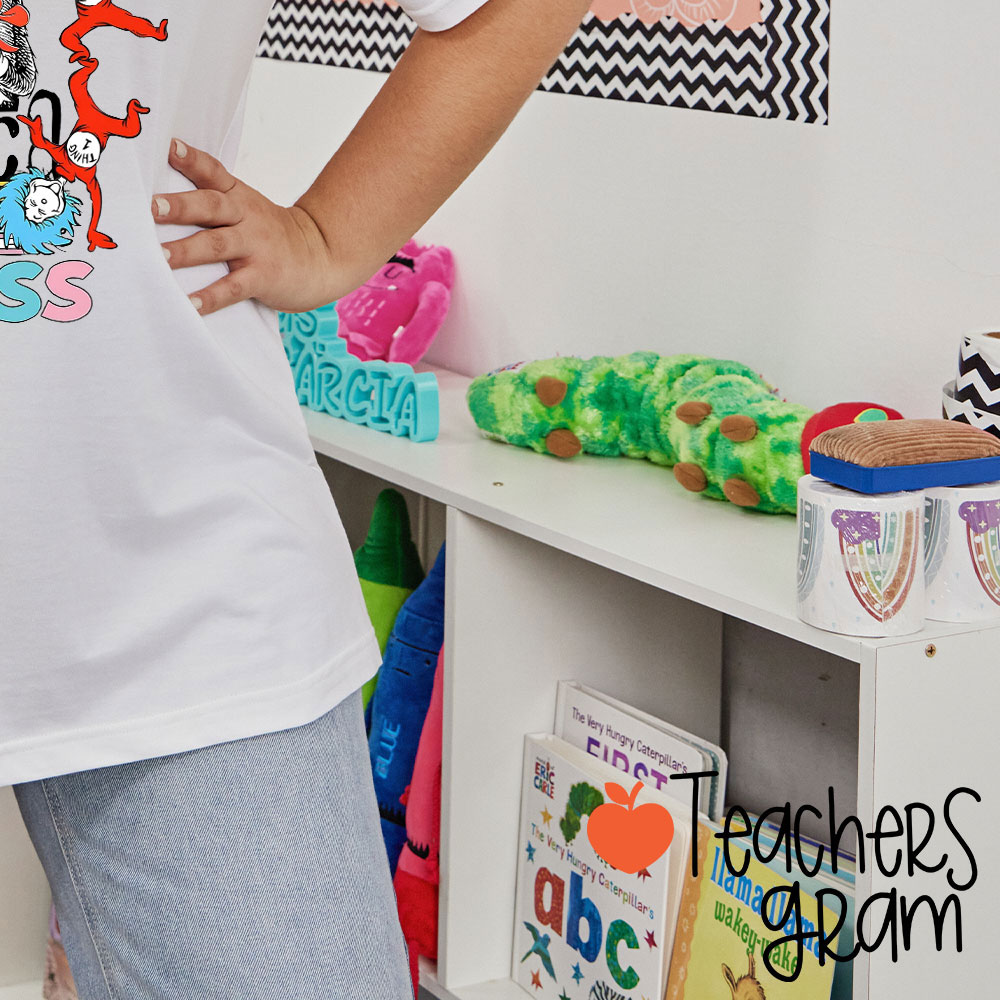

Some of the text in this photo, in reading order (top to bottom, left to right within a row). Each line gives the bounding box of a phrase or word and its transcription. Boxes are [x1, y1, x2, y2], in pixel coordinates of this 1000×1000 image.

[68, 143, 98, 164] THING
[82, 138, 92, 150] 1
[291, 345, 418, 436] ARCIA
[374, 714, 401, 780] BLUE
[534, 761, 556, 786] ERIC
[571, 706, 688, 775] The Very Hungry Caterpillar's
[533, 775, 555, 800] CARLE
[531, 822, 655, 920] The Very Hungry Caterpillar's
[710, 845, 762, 917] llama
[534, 866, 641, 991] abc
